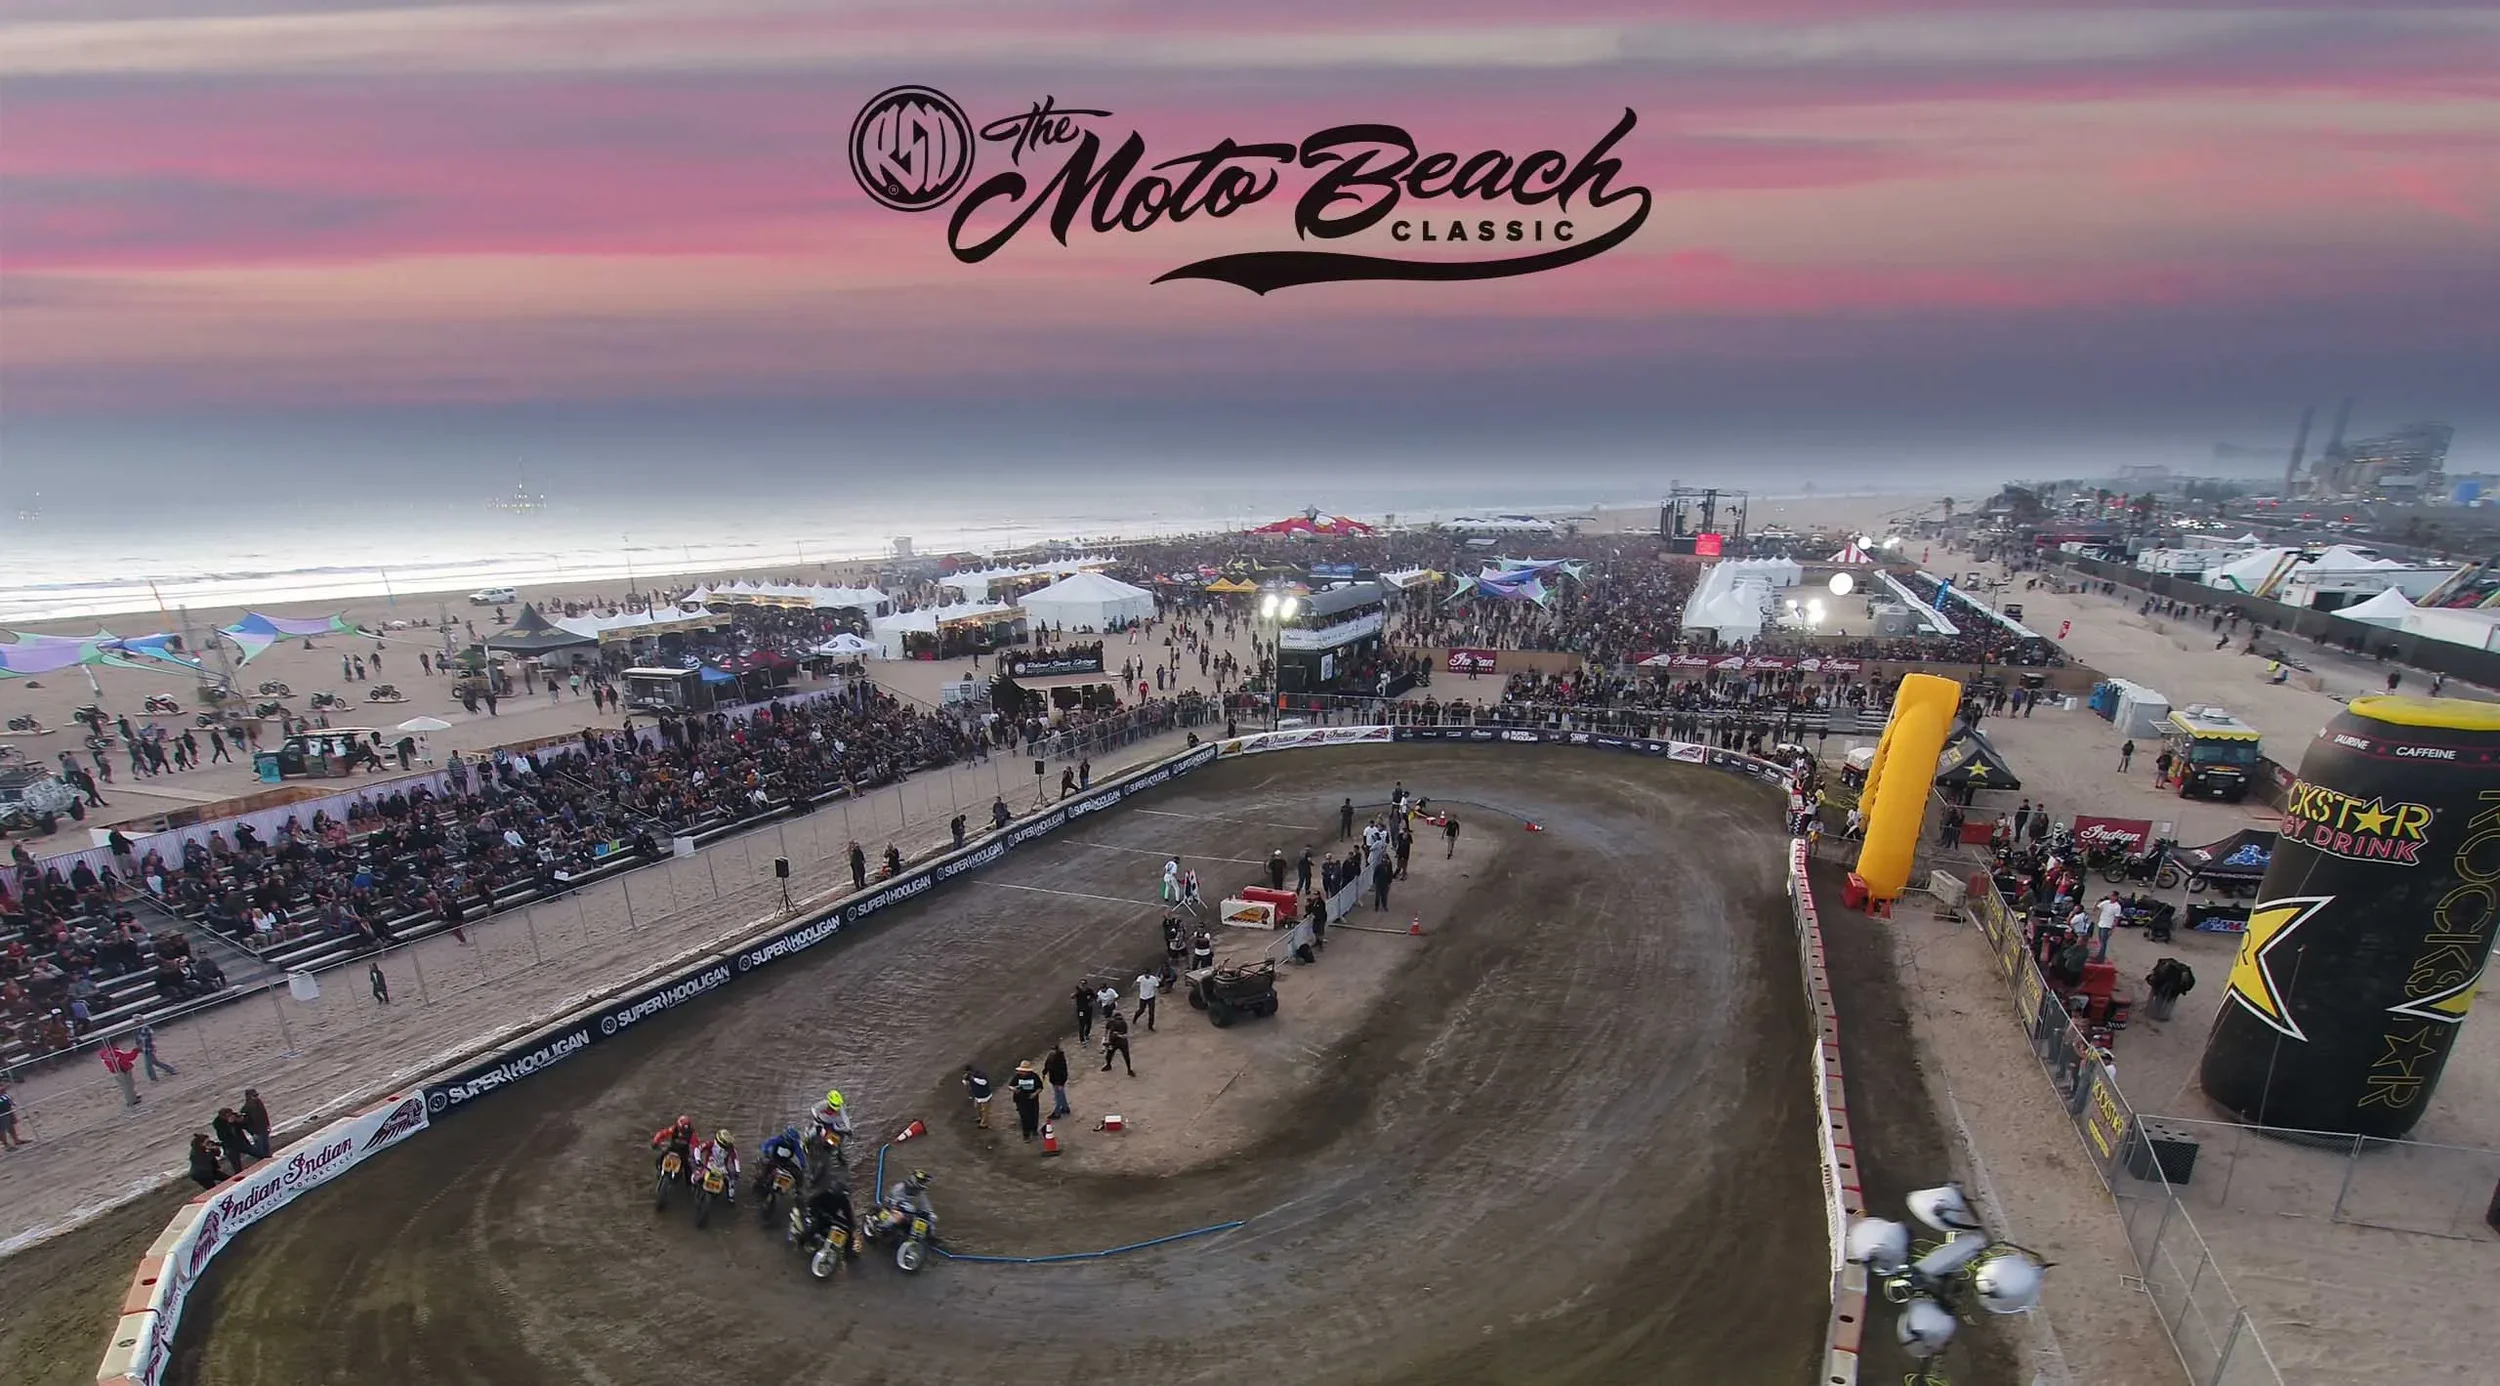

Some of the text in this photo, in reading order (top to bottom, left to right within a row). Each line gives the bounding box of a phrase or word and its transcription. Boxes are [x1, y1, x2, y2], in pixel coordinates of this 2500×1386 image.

[2396, 746, 2457, 760] CAFFEINE
[1014, 826, 1035, 843] SUPER
[2081, 824, 2141, 841] Indian
[2313, 824, 2421, 861] DRINK
[944, 841, 1004, 877] SUPER HOOLIGAN
[857, 875, 932, 916] SUPER HOOLIGAN
[751, 940, 788, 965] SUPER
[790, 915, 840, 948] HOOLIGAN
[617, 996, 663, 1027] SUPER
[667, 965, 731, 1003] HOOLIGAN
[449, 1068, 508, 1104] SUPER
[510, 1029, 591, 1078] HOOLIGAN
[283, 1138, 352, 1185] Indian
[220, 1176, 281, 1222] Indian
